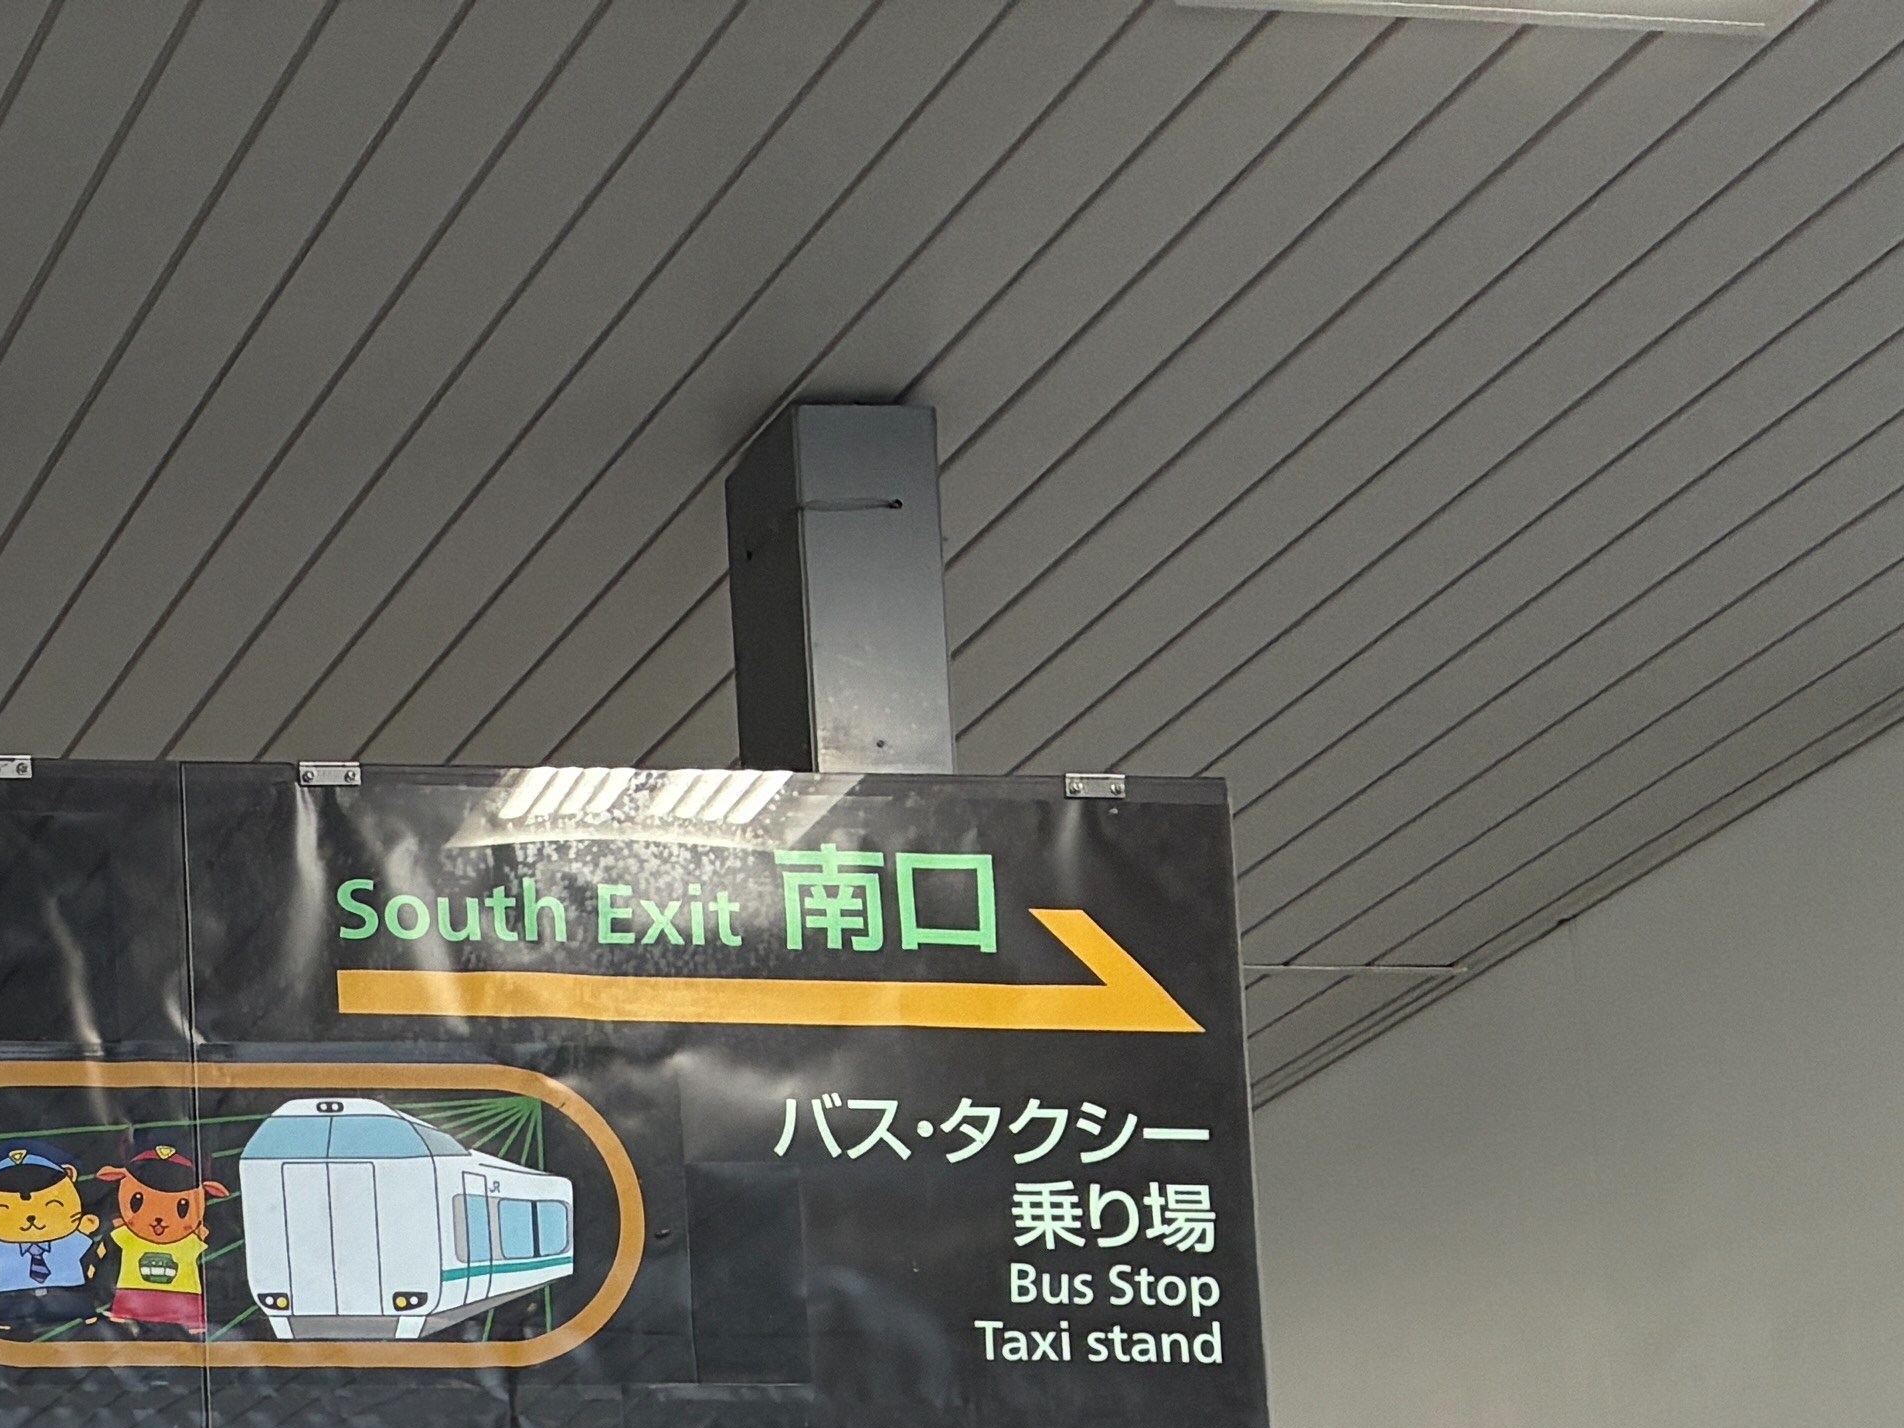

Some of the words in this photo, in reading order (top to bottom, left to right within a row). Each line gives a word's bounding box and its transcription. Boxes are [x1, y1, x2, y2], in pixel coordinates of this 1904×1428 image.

[337, 879, 568, 945] South
[596, 884, 742, 947] Exit
[774, 844, 998, 955] 南口
[774, 1097, 1211, 1163] バス・タクシー
[1011, 1181, 1217, 1254] 乗り場
[1010, 1266, 1095, 1305] Bus
[1109, 1267, 1221, 1315] Stop
[974, 1321, 1072, 1362] Taxi
[1086, 1323, 1224, 1364] stand
